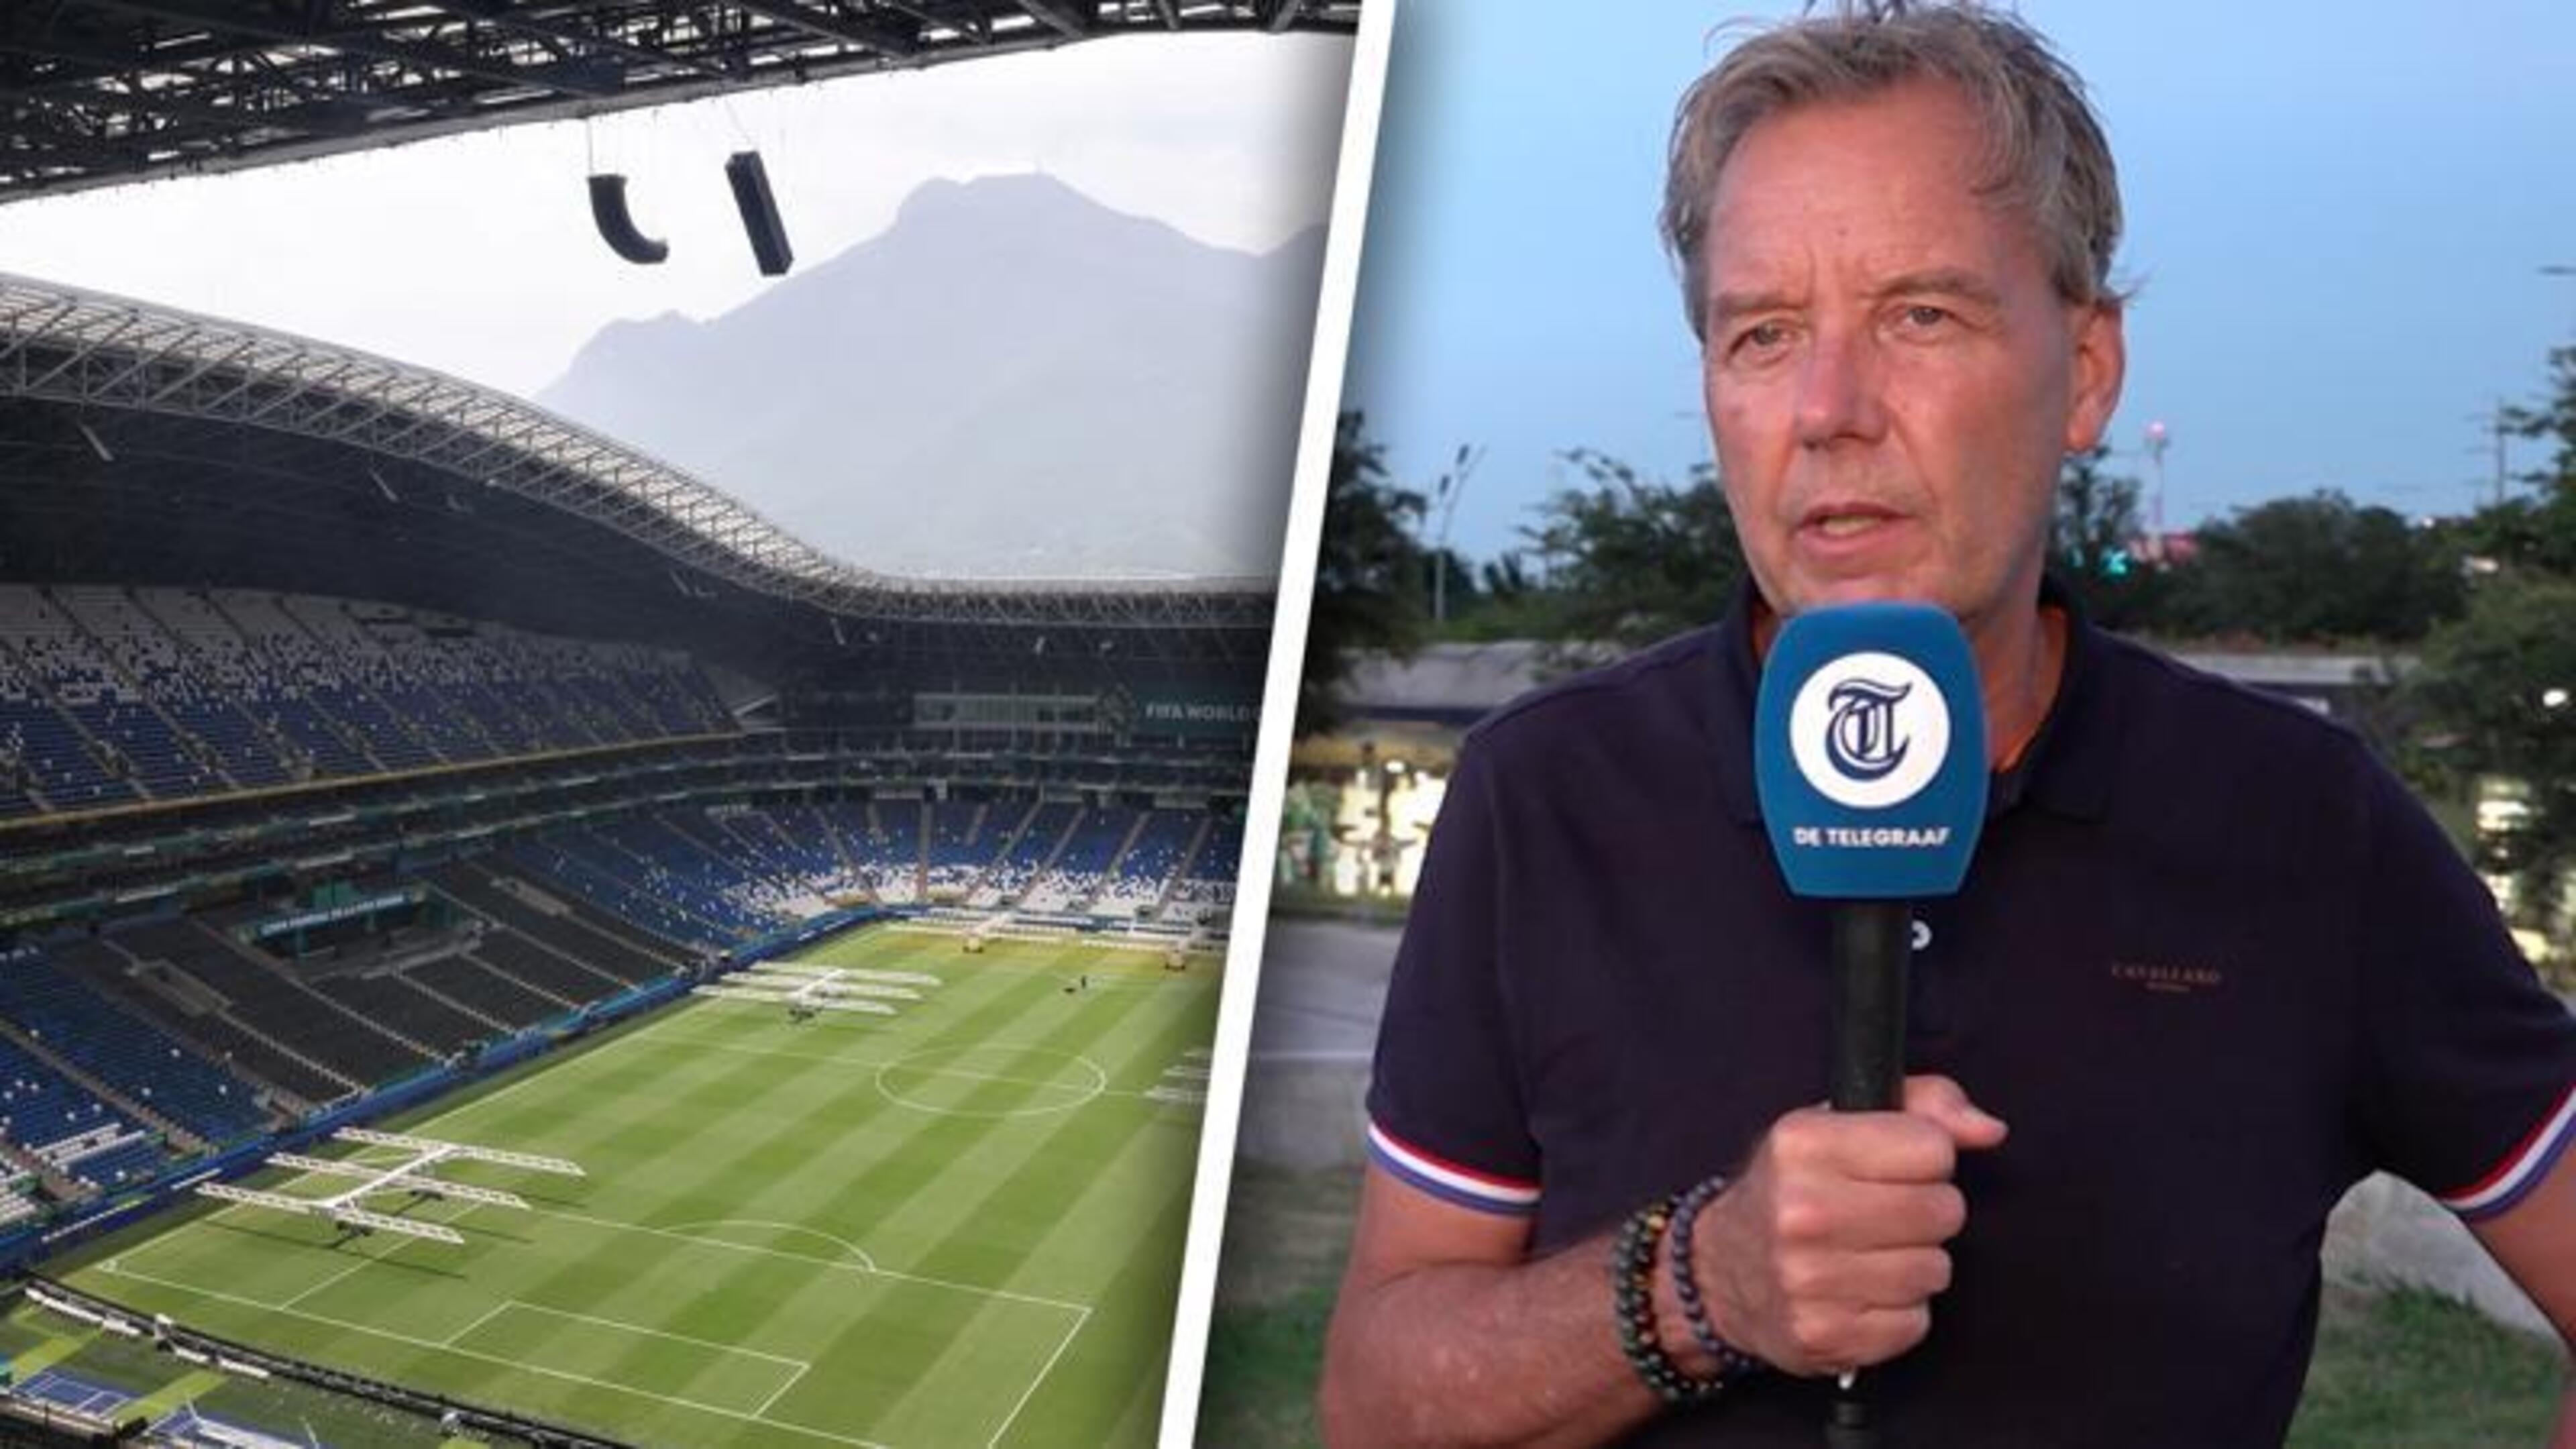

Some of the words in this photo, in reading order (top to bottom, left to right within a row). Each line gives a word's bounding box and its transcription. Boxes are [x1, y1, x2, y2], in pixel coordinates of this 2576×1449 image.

[1145, 704, 1183, 720] FIFA
[1185, 704, 1250, 722] WORLD
[1793, 826, 1821, 847] DE
[1825, 826, 1951, 847] TELEGRAAF
